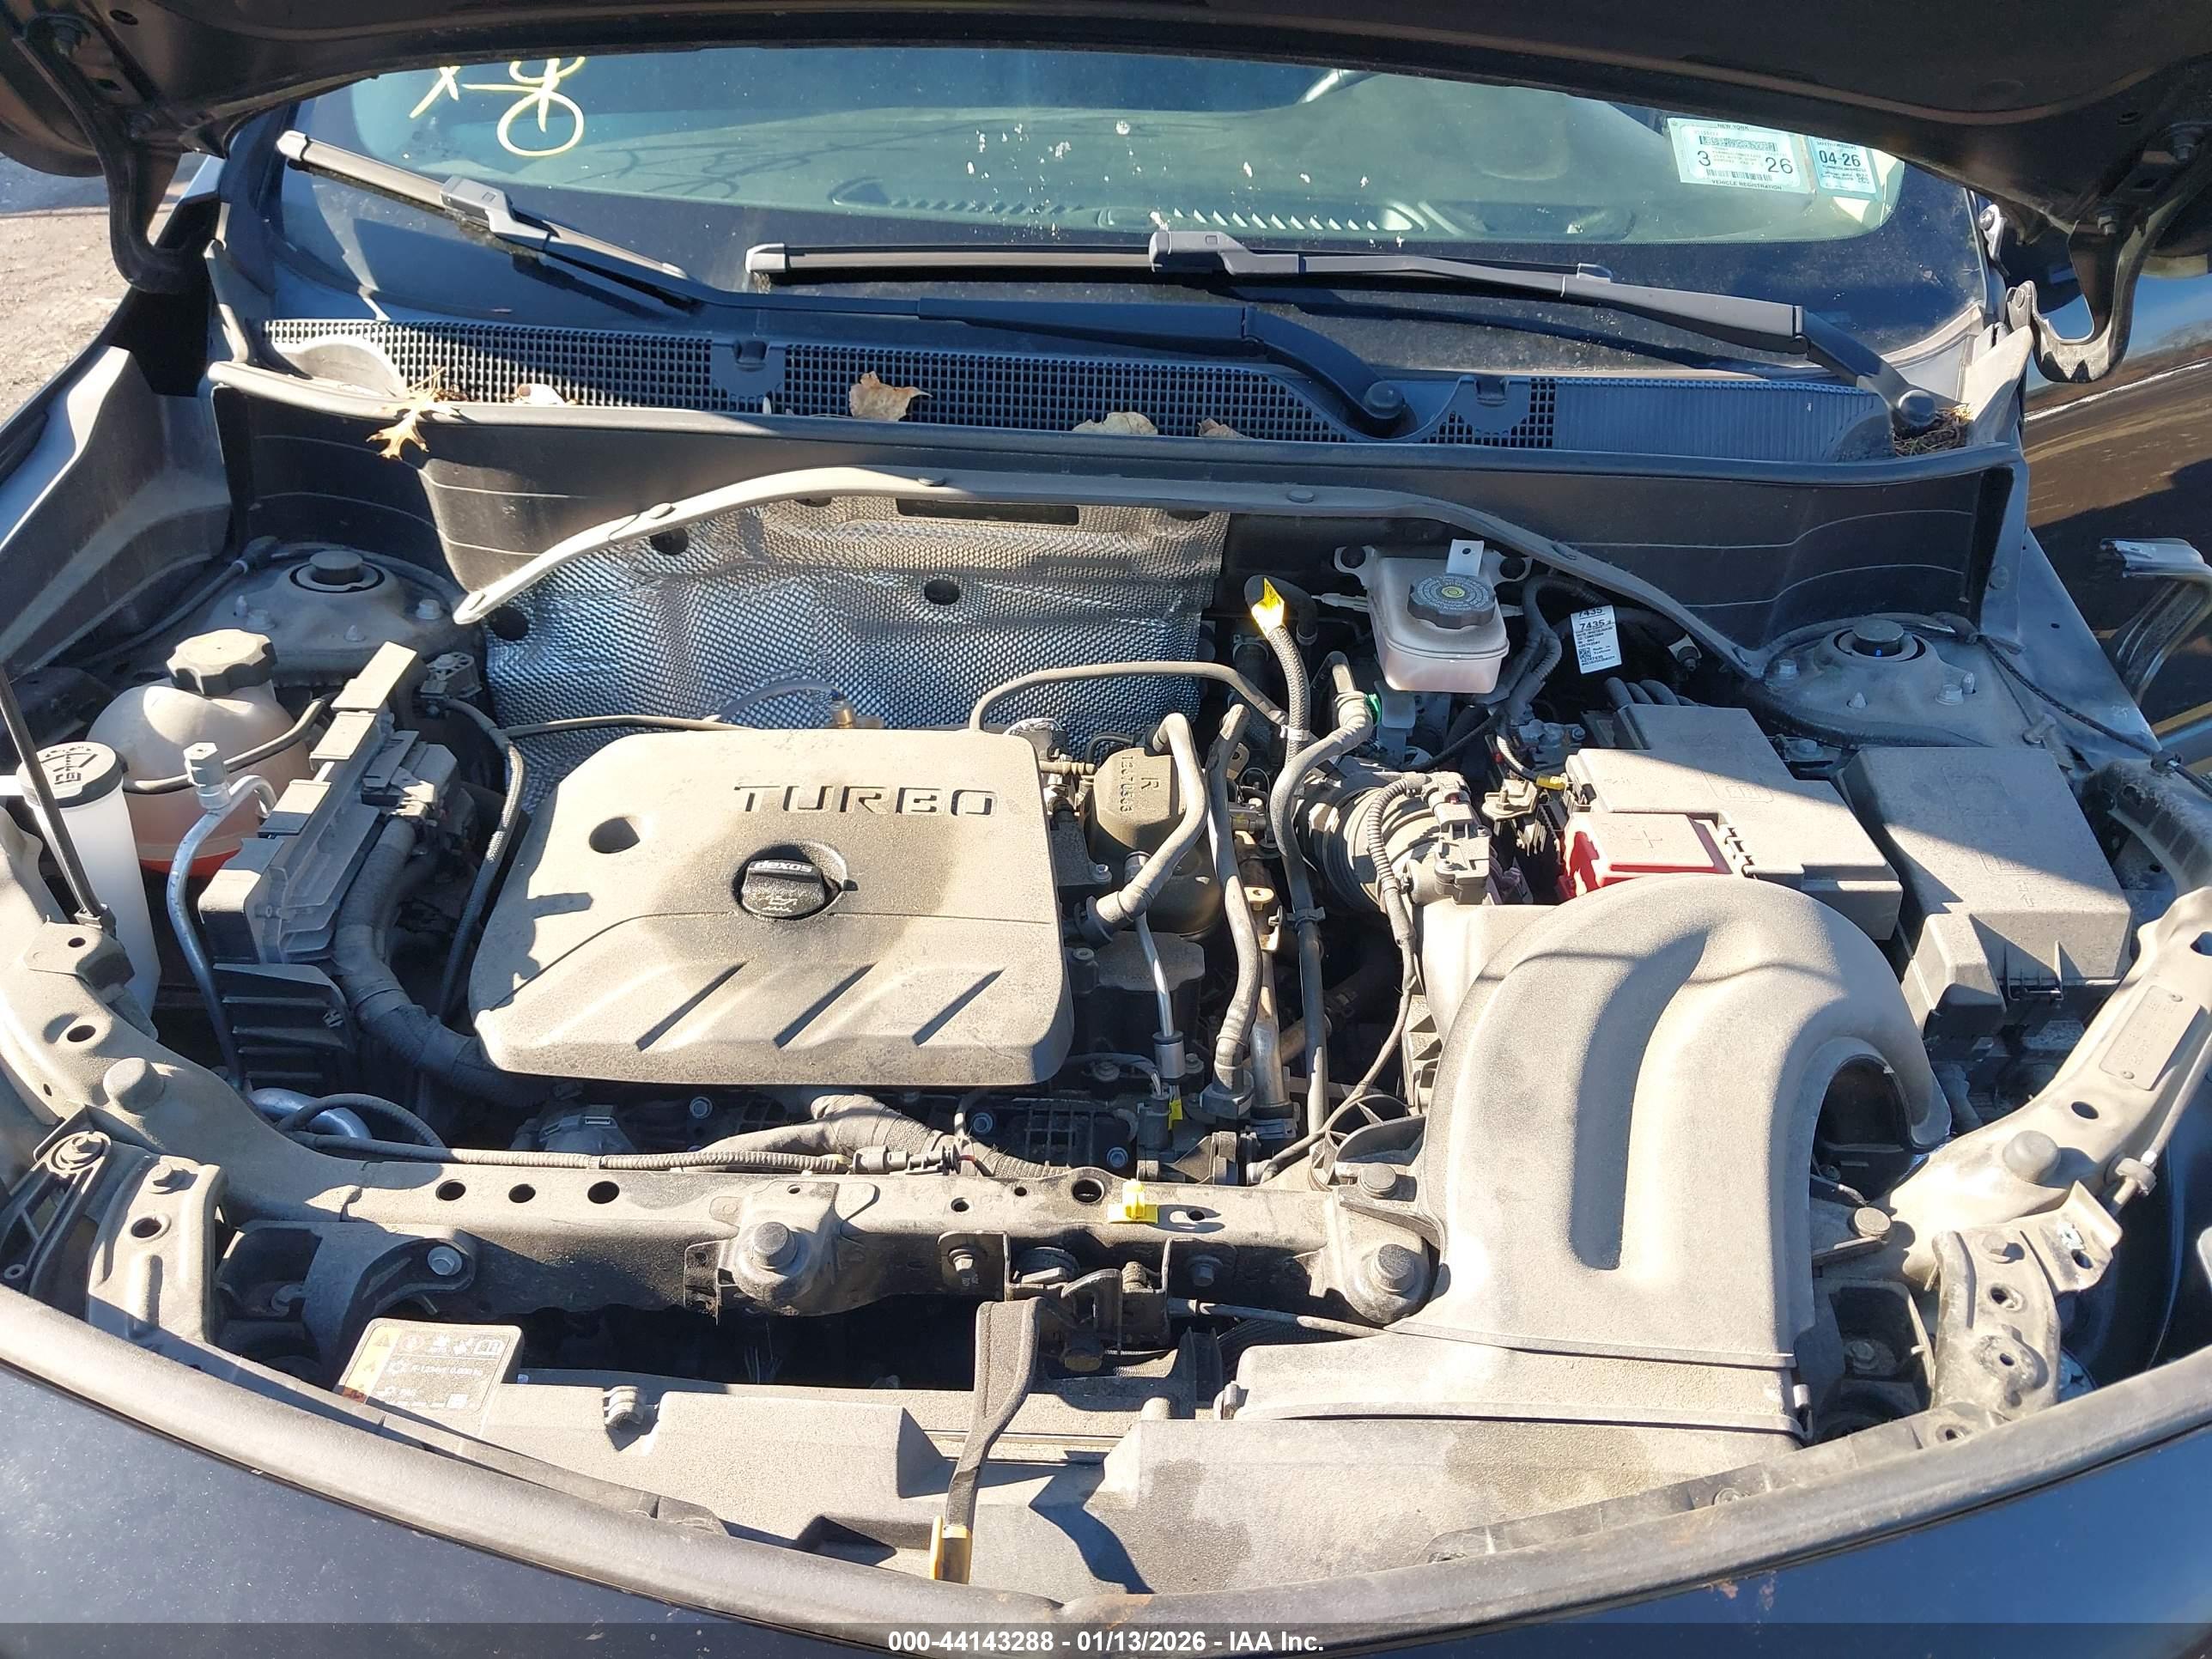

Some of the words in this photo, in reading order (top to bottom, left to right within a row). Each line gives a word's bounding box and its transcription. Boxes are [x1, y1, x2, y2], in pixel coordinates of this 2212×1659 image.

[1697, 150, 1711, 167] 3
[1765, 157, 1794, 174] 26
[1819, 150, 1861, 167] 04-26
[1739, 181, 1783, 191] REGISTRATION
[1579, 619, 1605, 630] 7435
[1141, 776, 1159, 790] R
[733, 785, 999, 817] TURBO
[754, 860, 813, 873] dexos
